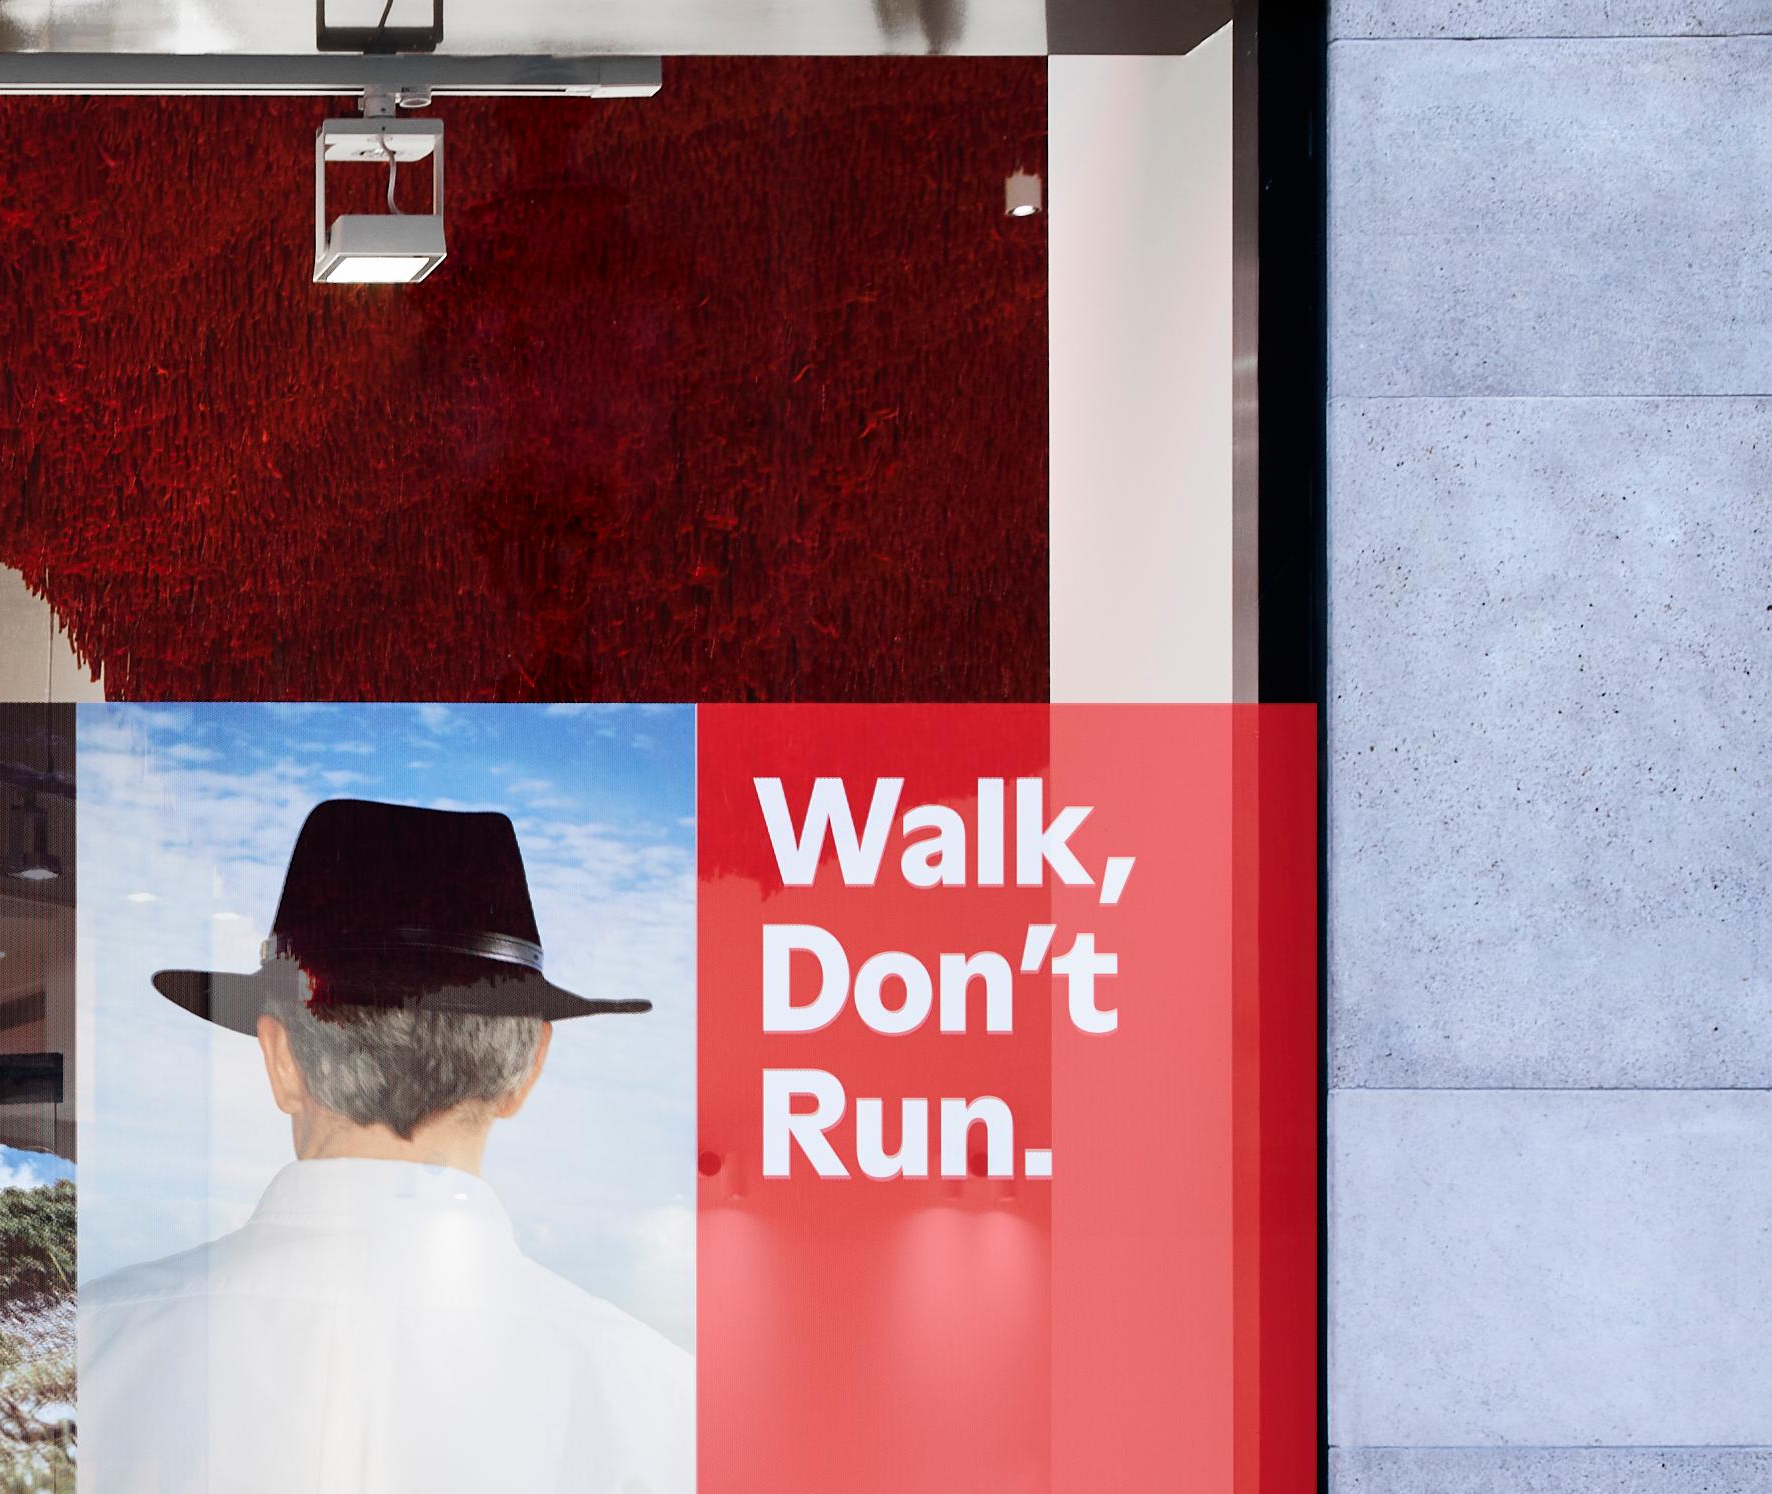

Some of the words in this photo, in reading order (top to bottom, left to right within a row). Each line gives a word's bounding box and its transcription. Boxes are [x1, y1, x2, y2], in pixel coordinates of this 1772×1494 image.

[753, 777, 1136, 905] Walk,
[762, 924, 1118, 1035] Don’t
[763, 1069, 1053, 1179] Run.
